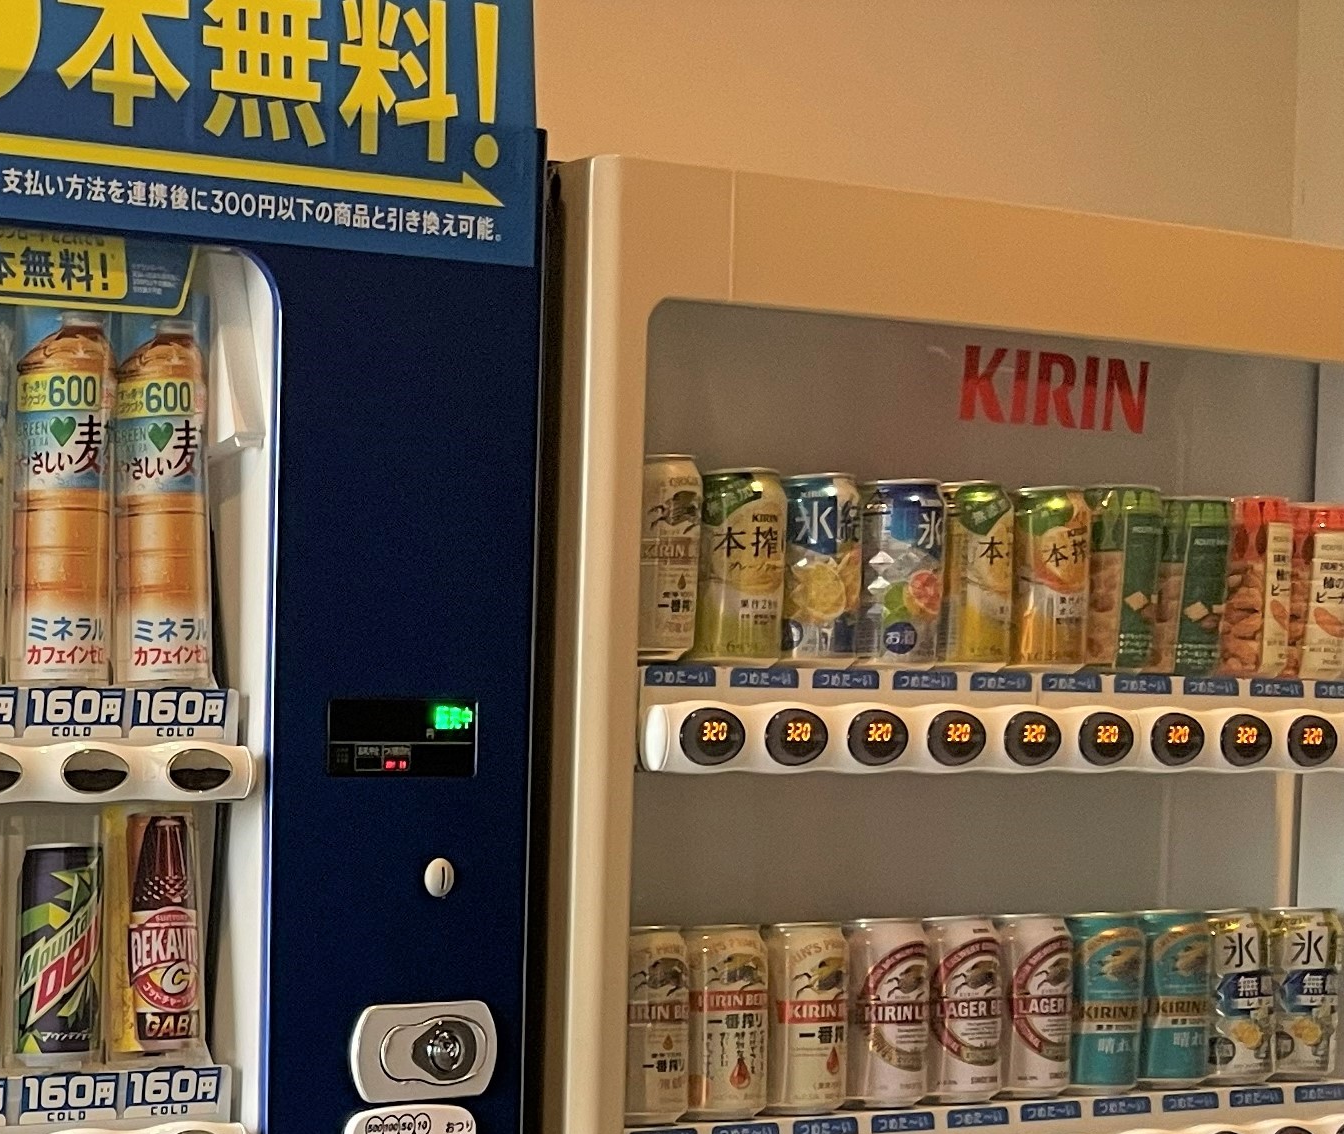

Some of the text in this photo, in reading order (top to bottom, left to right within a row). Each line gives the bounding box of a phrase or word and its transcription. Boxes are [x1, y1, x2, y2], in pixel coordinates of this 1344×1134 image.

[959, 345, 1151, 435] KIRIN
[794, 500, 835, 543] 氷
[135, 691, 225, 722] 160円
[703, 721, 728, 742] 320
[1097, 724, 1120, 743] 320
[1222, 932, 1257, 966] 氷
